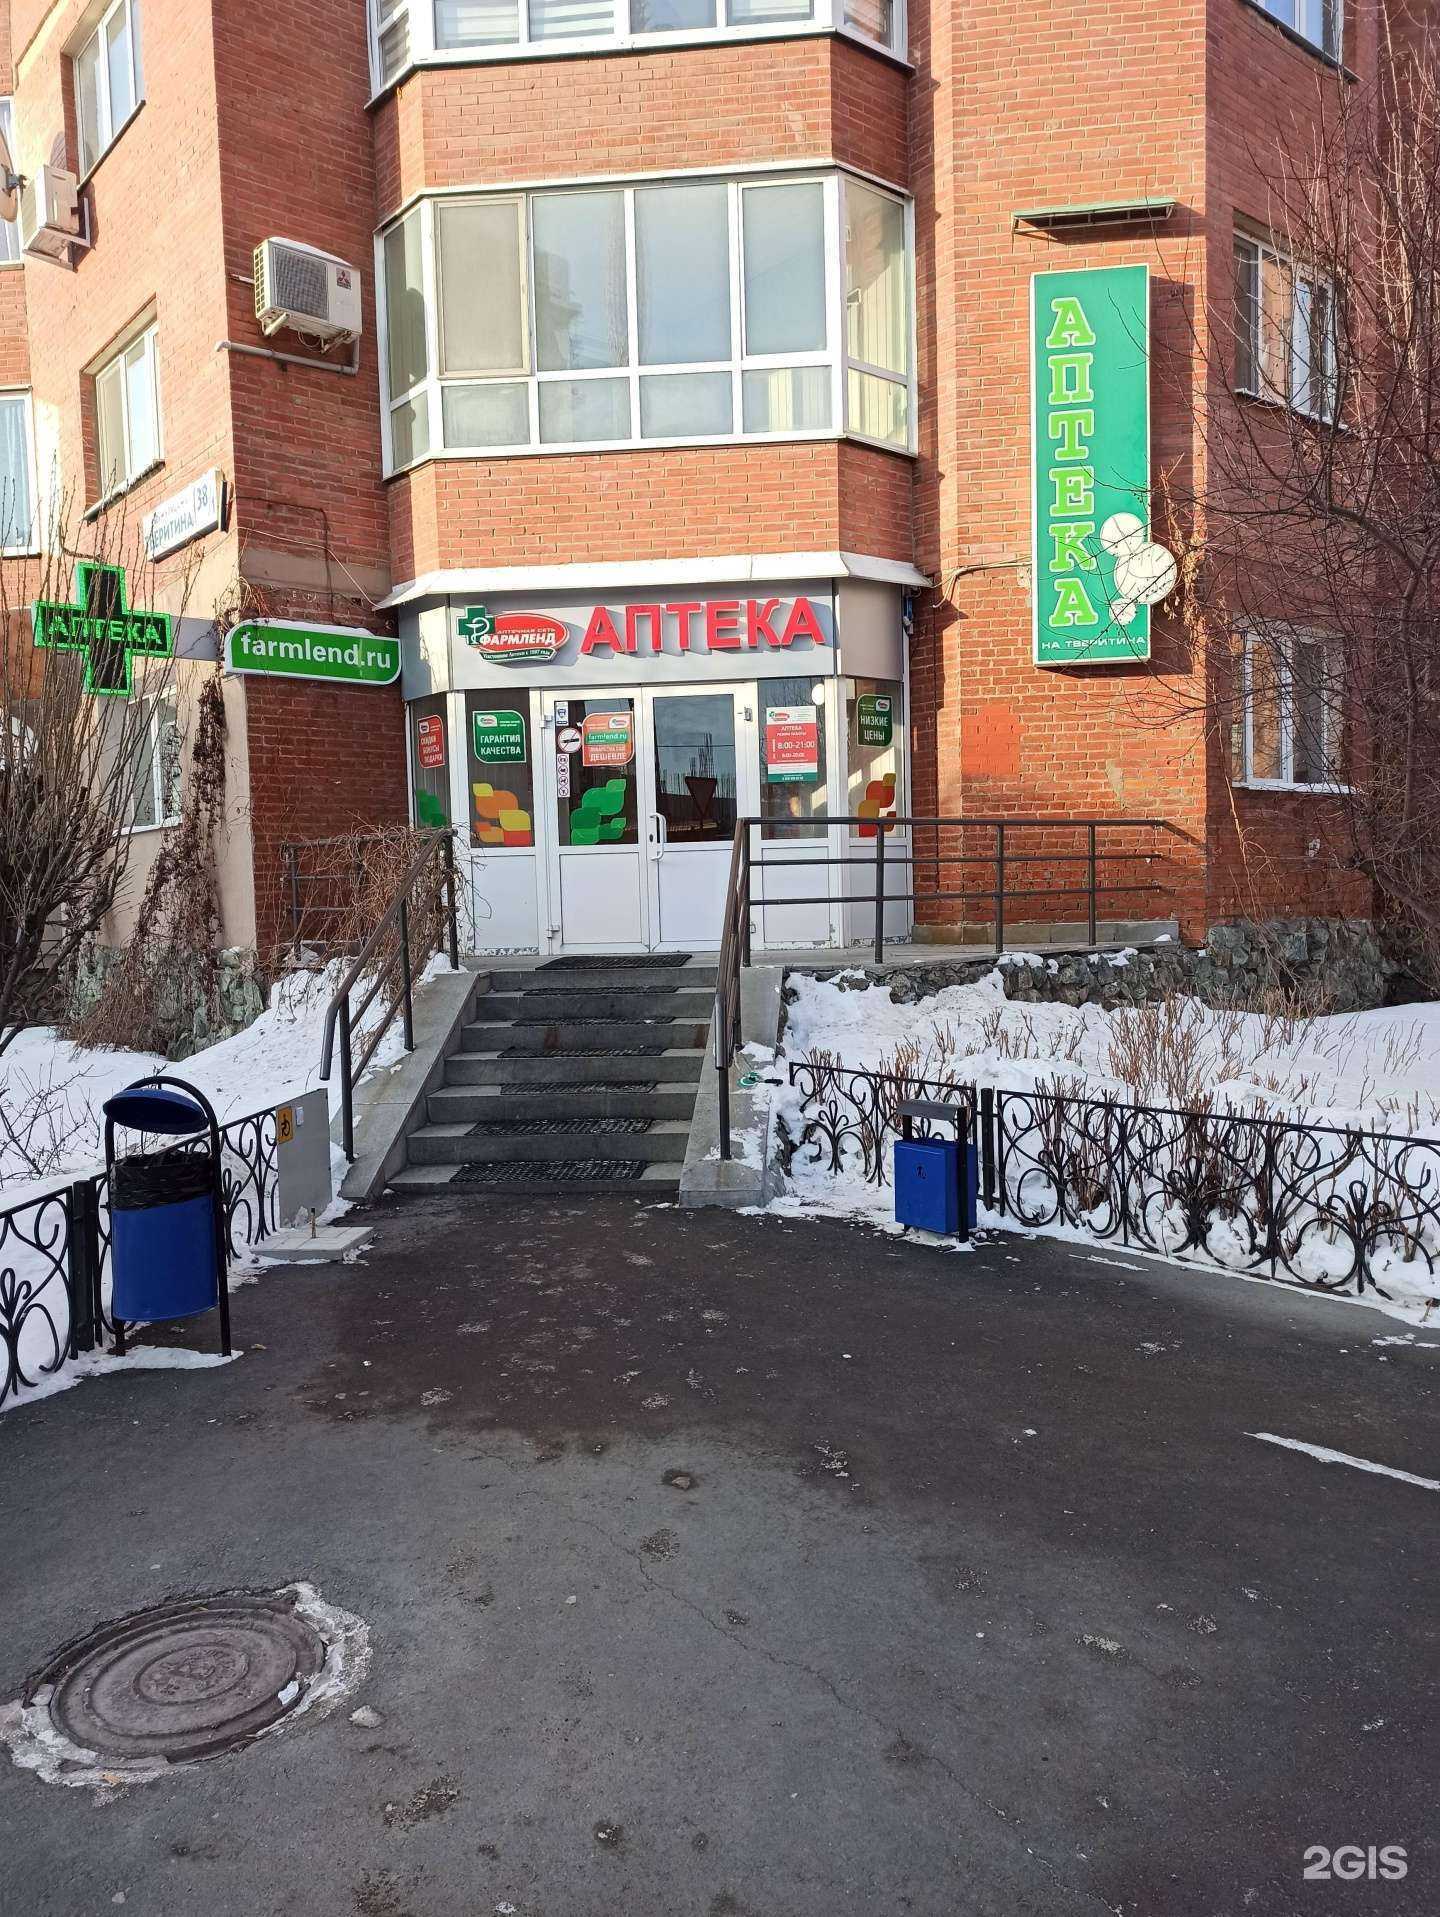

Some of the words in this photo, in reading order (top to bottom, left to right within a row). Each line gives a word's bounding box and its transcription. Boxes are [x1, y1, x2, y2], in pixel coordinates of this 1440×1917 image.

[1046, 296, 1098, 628] АПТЕКА
[48, 615, 163, 645] АПТЕКА
[580, 597, 826, 655] АПТЕКА
[480, 632, 556, 646] ФАРМЛЕНД
[1041, 641, 1060, 650] НА
[241, 632, 391, 668] farmlend.ru
[860, 715, 889, 727] НИЗКИЕ
[480, 734, 521, 743] ГАРАНТИЯ
[864, 730, 885, 741] ЦЕНЫ
[480, 746, 521, 755] КАЧЕСТВА
